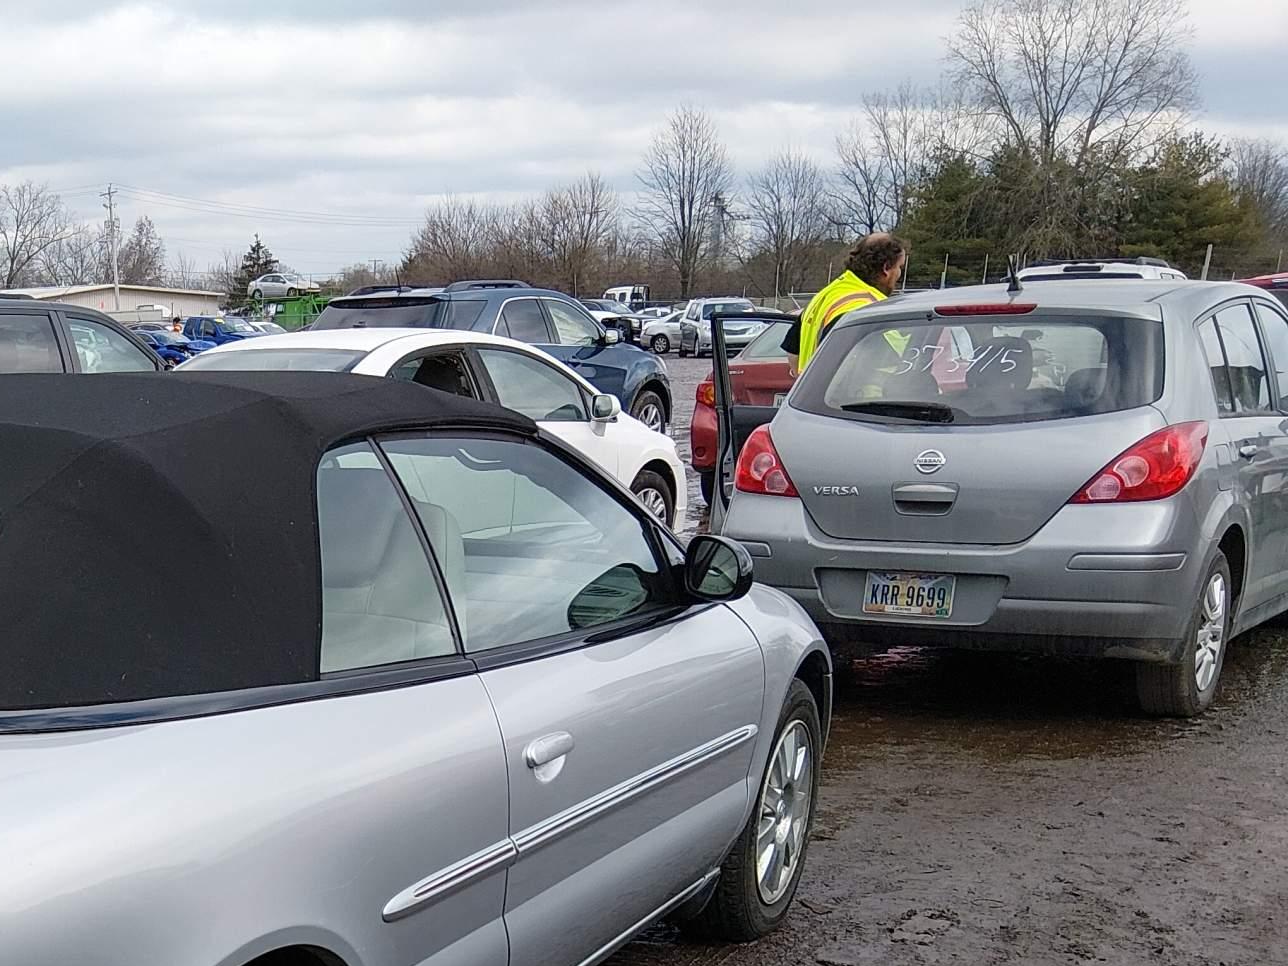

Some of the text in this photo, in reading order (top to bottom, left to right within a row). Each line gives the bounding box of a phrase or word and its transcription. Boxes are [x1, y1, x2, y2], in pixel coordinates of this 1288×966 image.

[813, 486, 860, 496] VERSA
[870, 583, 947, 609] KRR 9699
